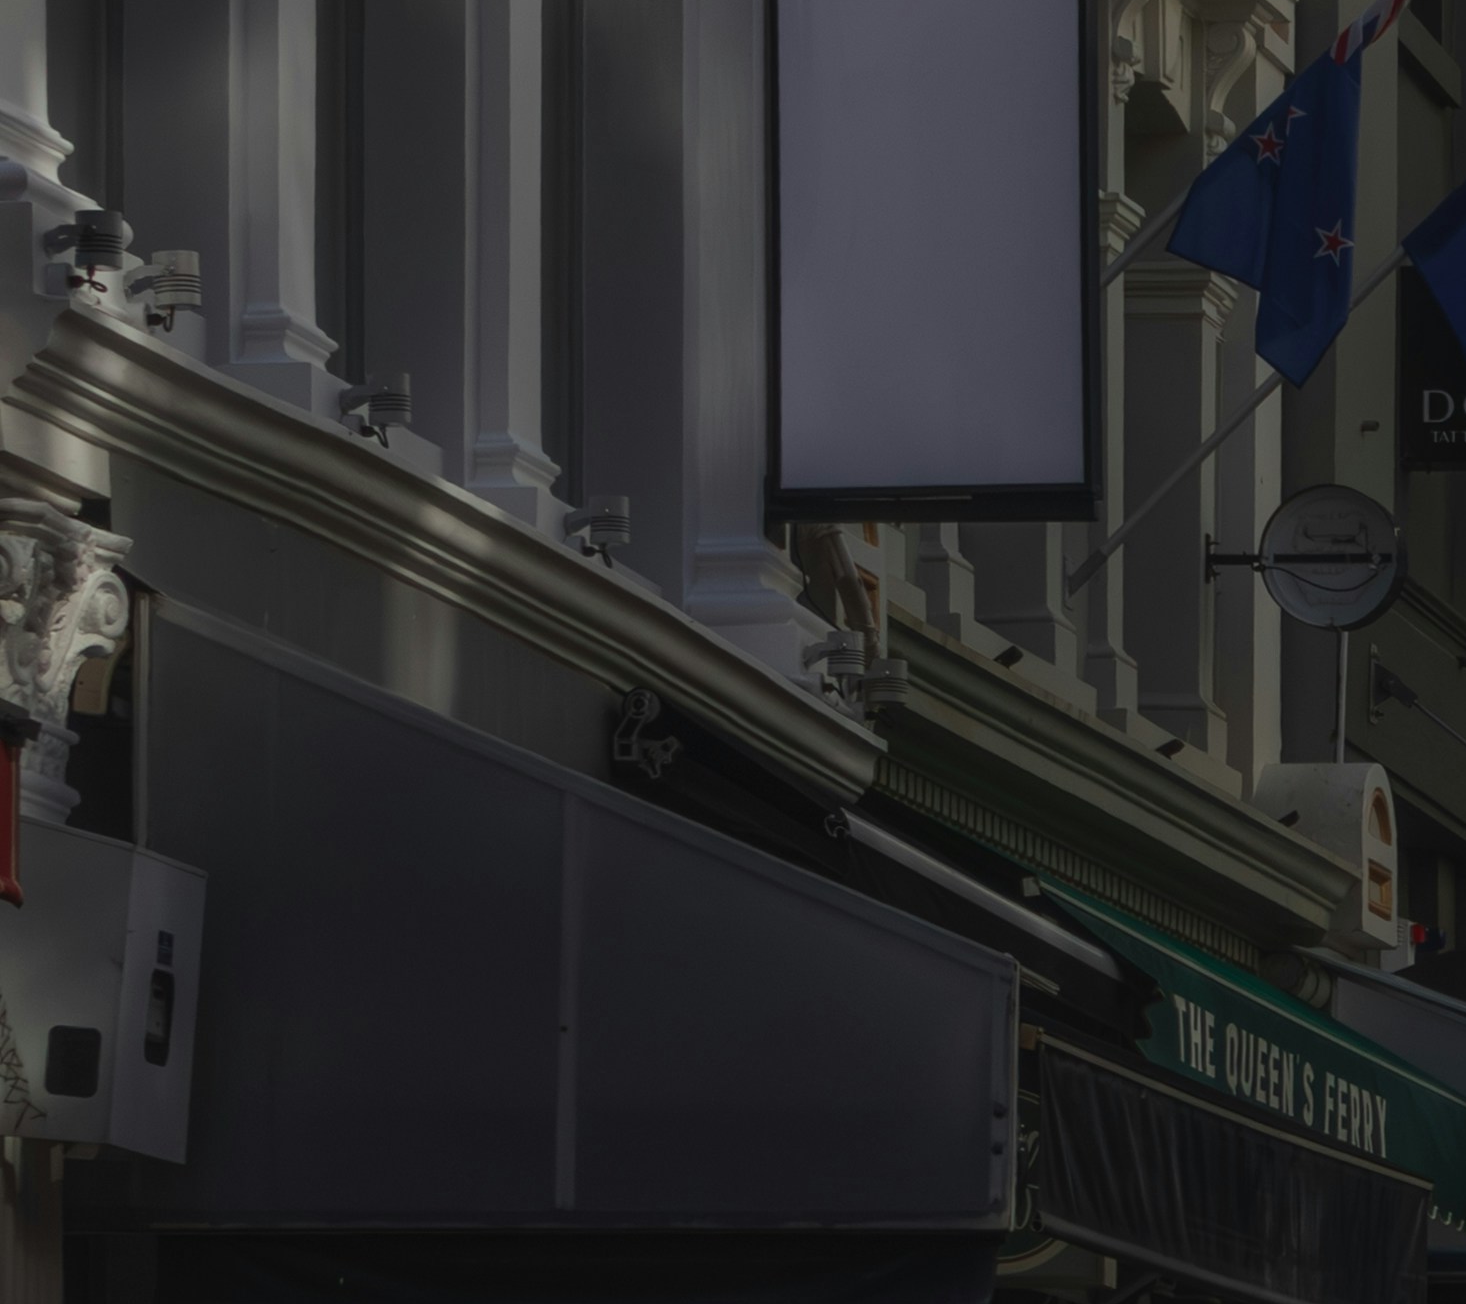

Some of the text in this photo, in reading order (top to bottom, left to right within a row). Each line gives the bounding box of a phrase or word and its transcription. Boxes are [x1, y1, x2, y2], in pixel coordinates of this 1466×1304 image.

[1172, 992, 1388, 1160] THE QUEEN'S FERRY
